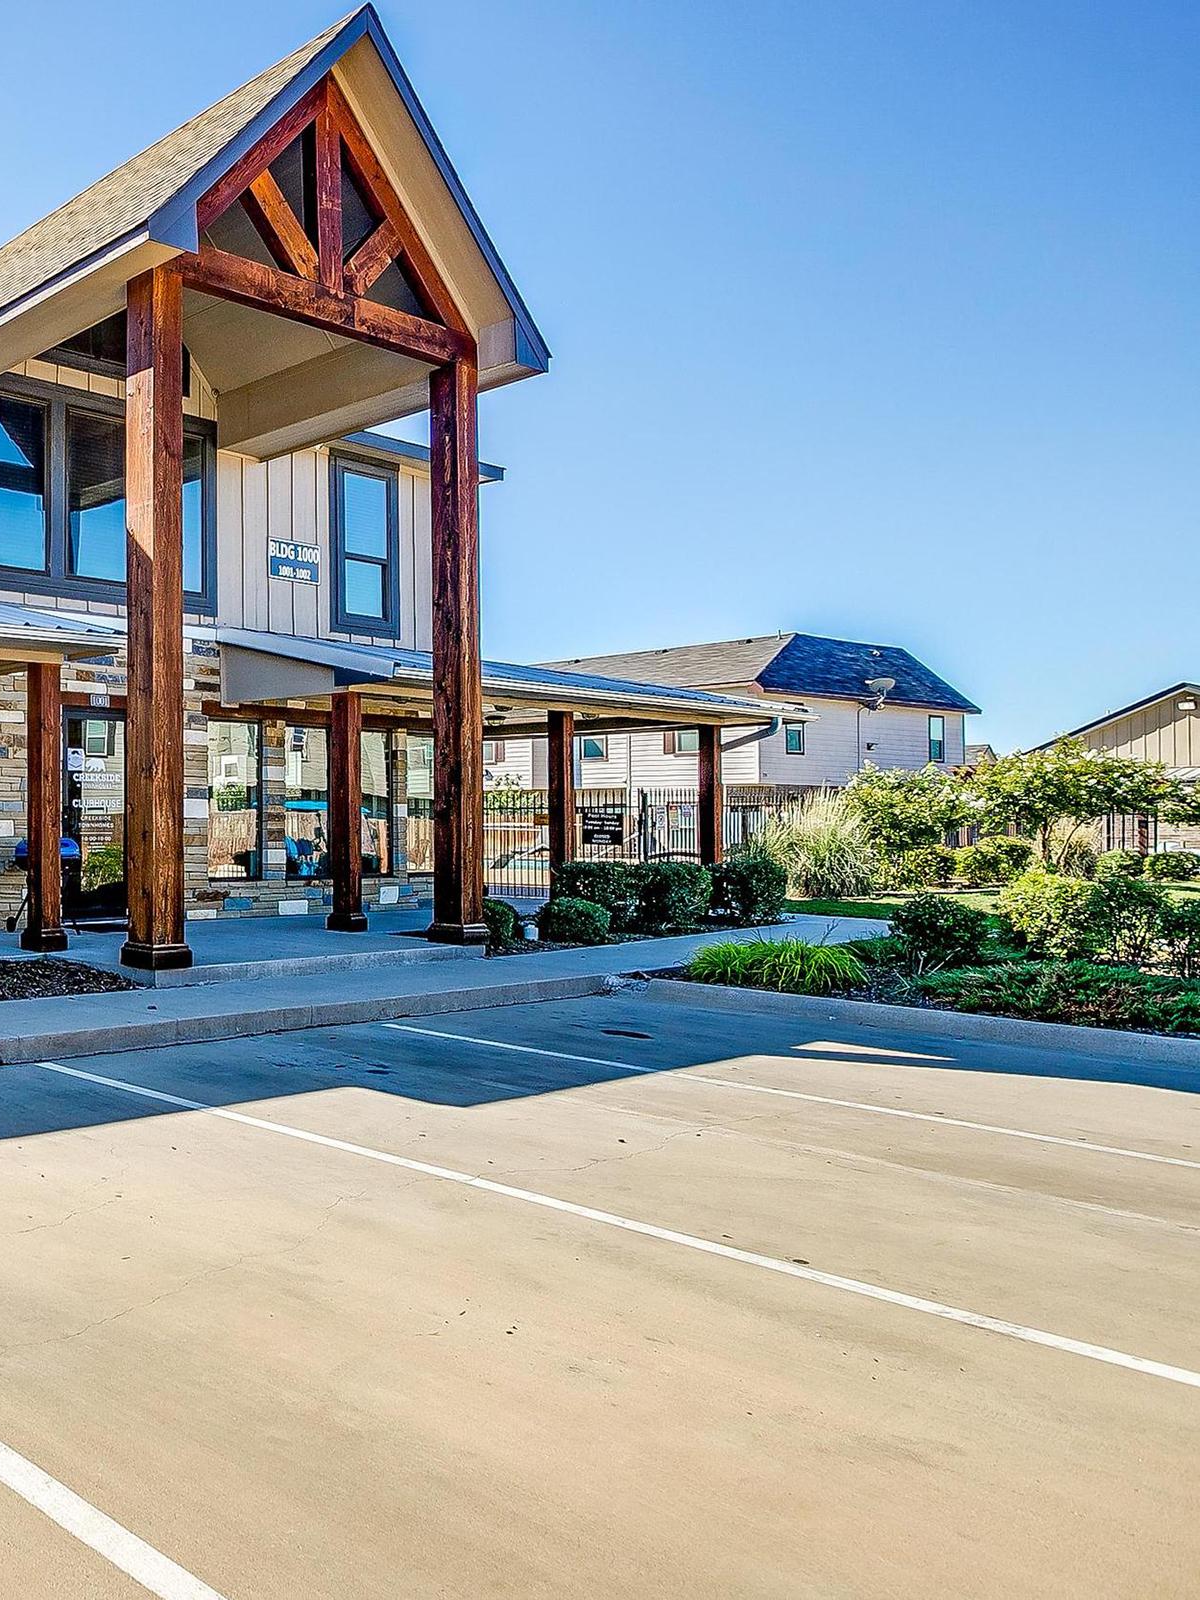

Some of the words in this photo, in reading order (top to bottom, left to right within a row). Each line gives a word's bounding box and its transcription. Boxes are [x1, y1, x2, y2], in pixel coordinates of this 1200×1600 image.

[269, 541, 295, 560] BLDG
[296, 546, 319, 564] 1000
[278, 564, 311, 580] 1001-1002
[72, 772, 121, 782] CREEKSIDE
[72, 798, 122, 808] CLUBHOUSE
